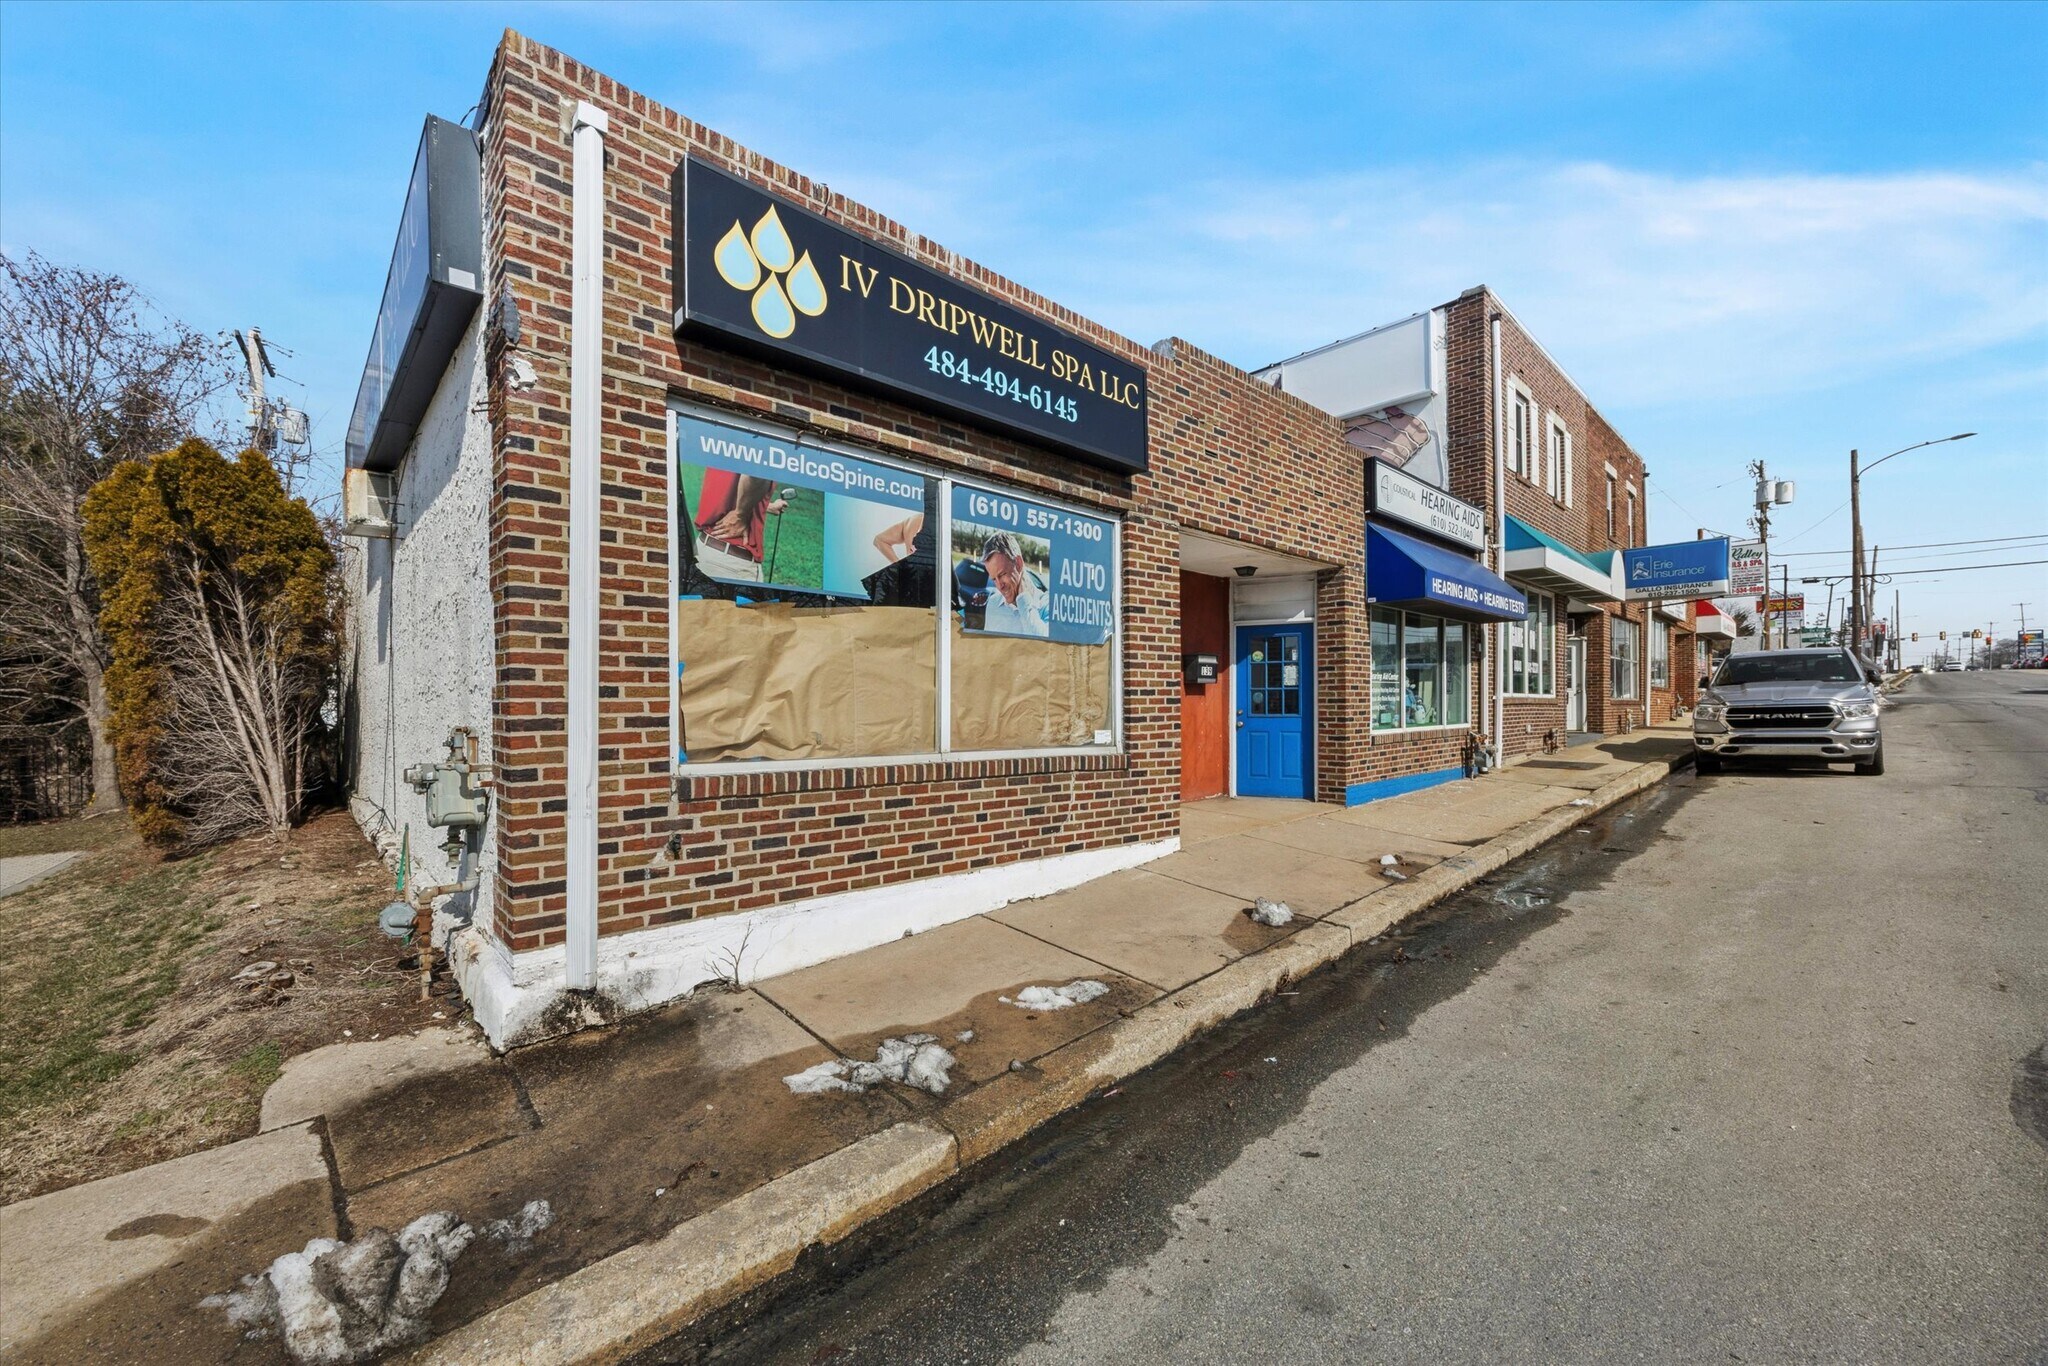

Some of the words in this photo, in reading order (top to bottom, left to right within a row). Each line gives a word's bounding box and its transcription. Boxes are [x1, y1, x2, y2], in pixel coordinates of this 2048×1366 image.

[839, 254, 879, 298] IV
[889, 276, 1046, 371] DRIPWELL
[1051, 349, 1095, 392] SPA
[1100, 369, 1140, 410] LLC
[923, 346, 1079, 423] 484-494-6145
[700, 442, 925, 501] www.DelcoSpine.com
[969, 493, 1019, 526] (610)
[1026, 508, 1102, 542] 557-1300
[1421, 488, 1460, 521] HEARING
[1461, 508, 1480, 530] AIDS
[1430, 514, 1447, 532] (610)
[1448, 521, 1473, 541] 522-1040
[1653, 560, 1673, 570] Erie
[1731, 547, 1763, 560] Ridley
[1060, 558, 1106, 592] AUTO
[1635, 585, 1662, 593] GALLO
[1664, 581, 1714, 590] INSURANCE
[1653, 566, 1705, 579] Insurance
[1052, 593, 1113, 627] ACCIDENTS
[1432, 577, 1463, 599] HEARING
[1463, 586, 1478, 603] AIDS
[1484, 591, 1509, 611] HEARING
[1509, 599, 1525, 615] TESTS
[1648, 588, 1700, 598] 610-237-1500
